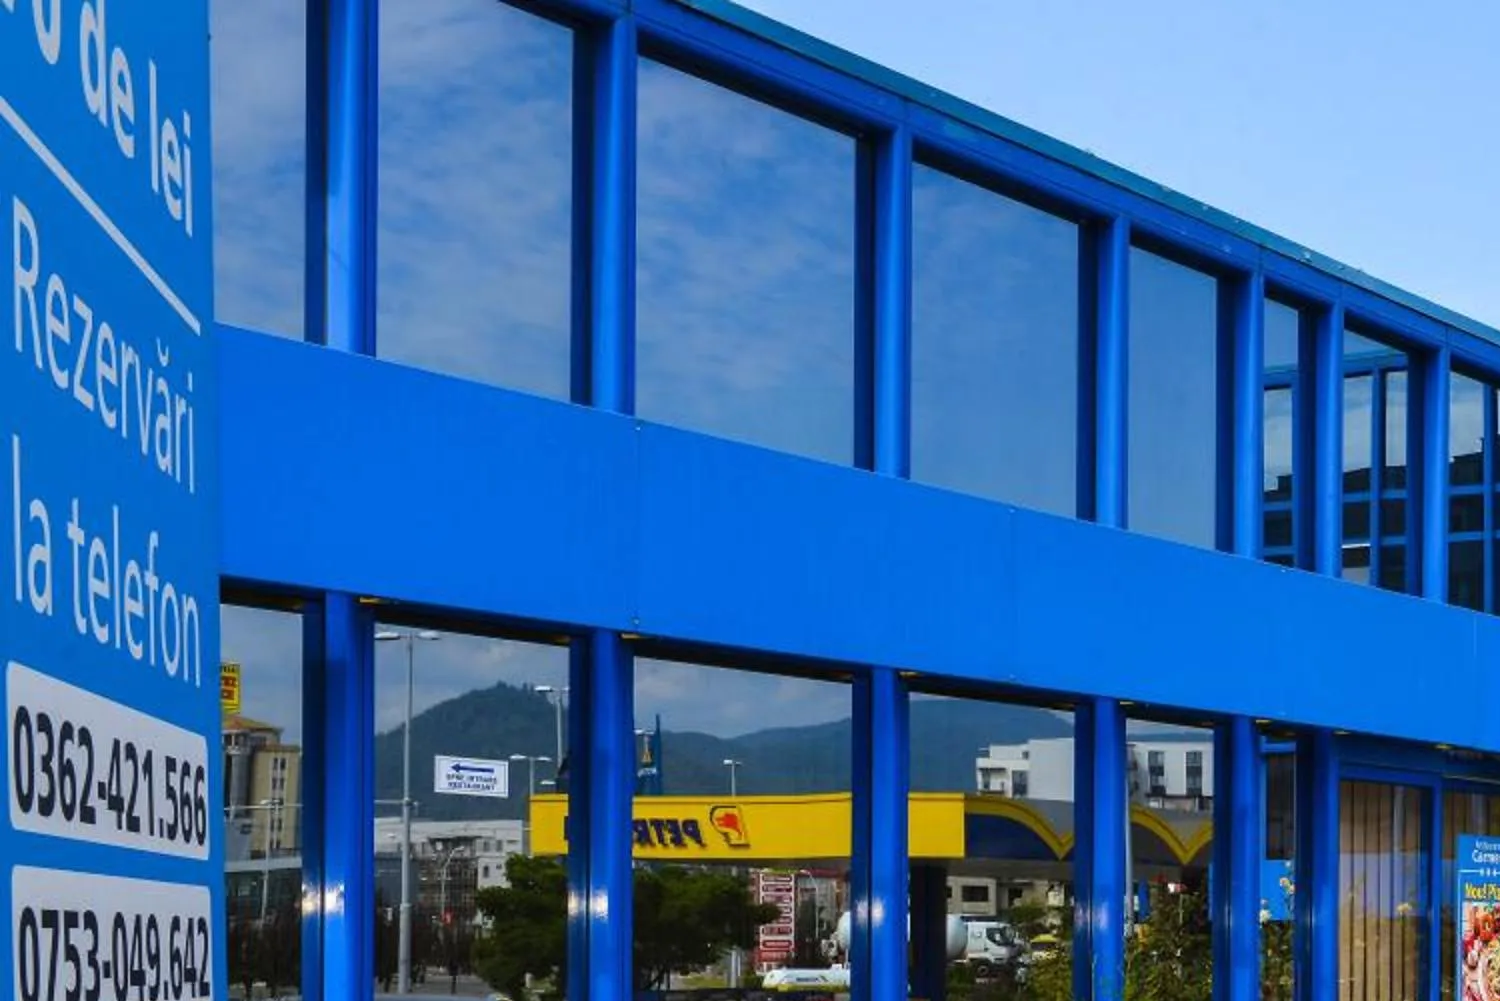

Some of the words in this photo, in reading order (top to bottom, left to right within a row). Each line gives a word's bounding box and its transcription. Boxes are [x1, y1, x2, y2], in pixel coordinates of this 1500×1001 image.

[79, 0, 136, 159] de
[149, 58, 193, 238] lei
[13, 194, 195, 494] Rezervări
[12, 433, 53, 617] la
[66, 497, 201, 689] telefon
[13, 704, 207, 847] 0362-421.566
